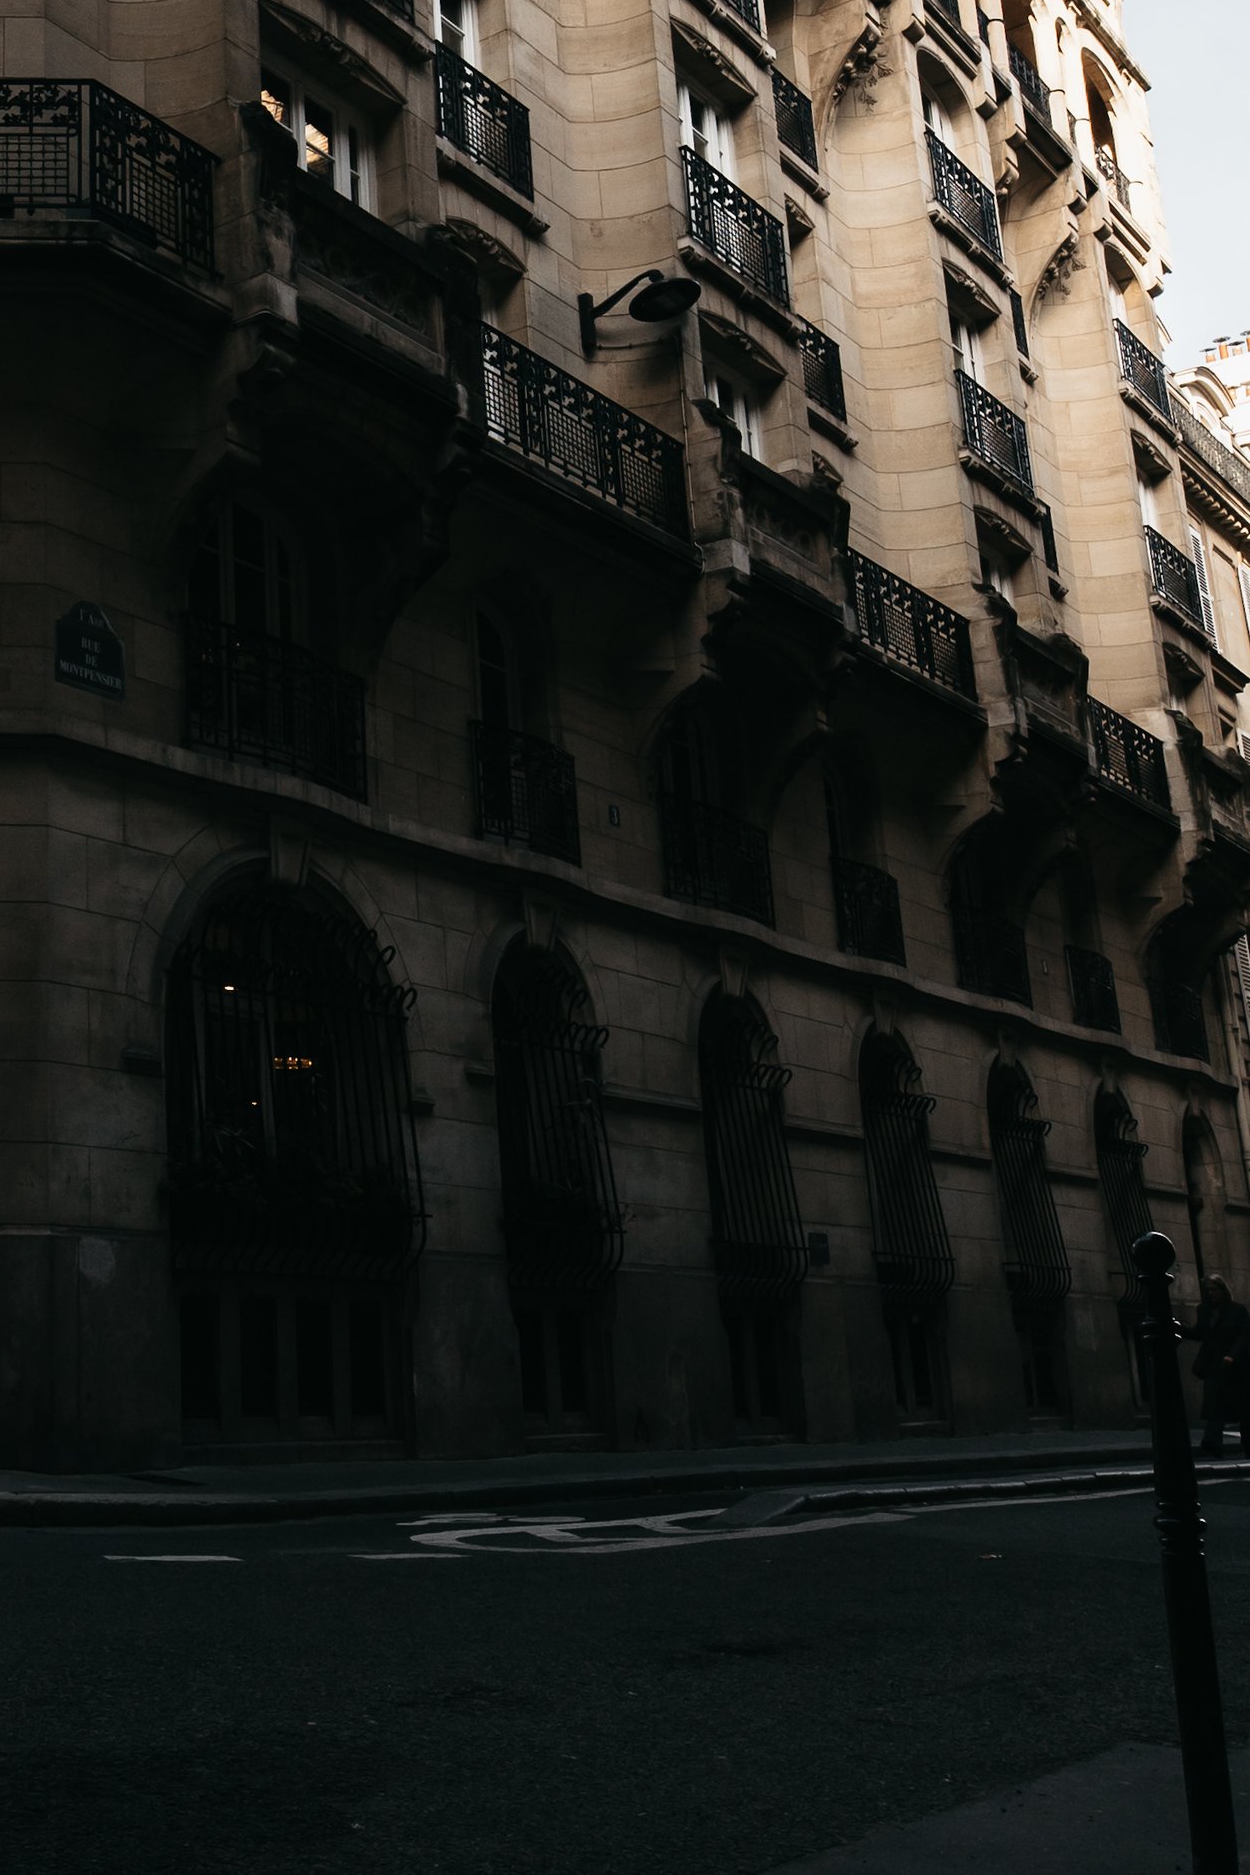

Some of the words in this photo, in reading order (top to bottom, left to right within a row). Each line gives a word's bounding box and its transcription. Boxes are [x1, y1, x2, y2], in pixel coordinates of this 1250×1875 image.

[81, 636, 101, 654] RUE
[85, 653, 99, 667] DE
[60, 659, 122, 690] MONTPENSIER
